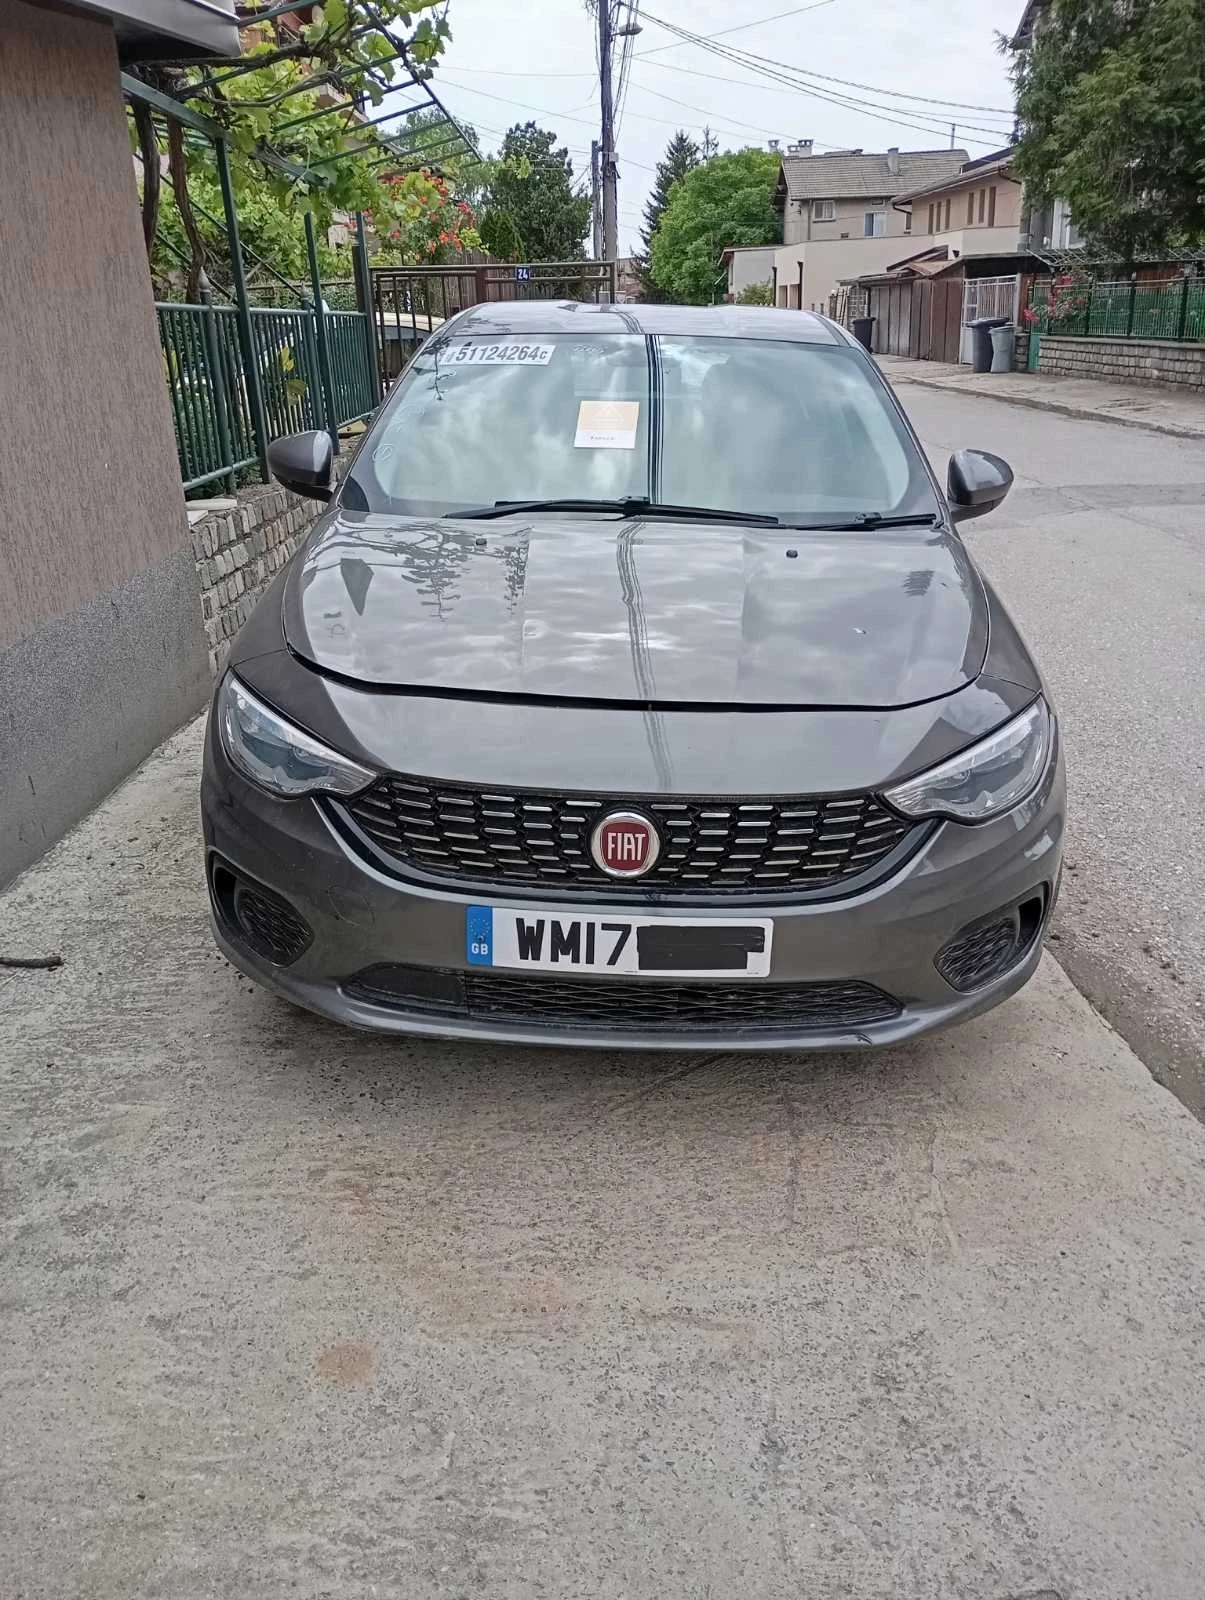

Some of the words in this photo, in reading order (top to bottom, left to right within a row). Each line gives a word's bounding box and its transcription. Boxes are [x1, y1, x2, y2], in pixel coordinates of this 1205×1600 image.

[518, 268, 529, 280] 24
[607, 832, 646, 861] FIAT
[471, 942, 489, 956] GB
